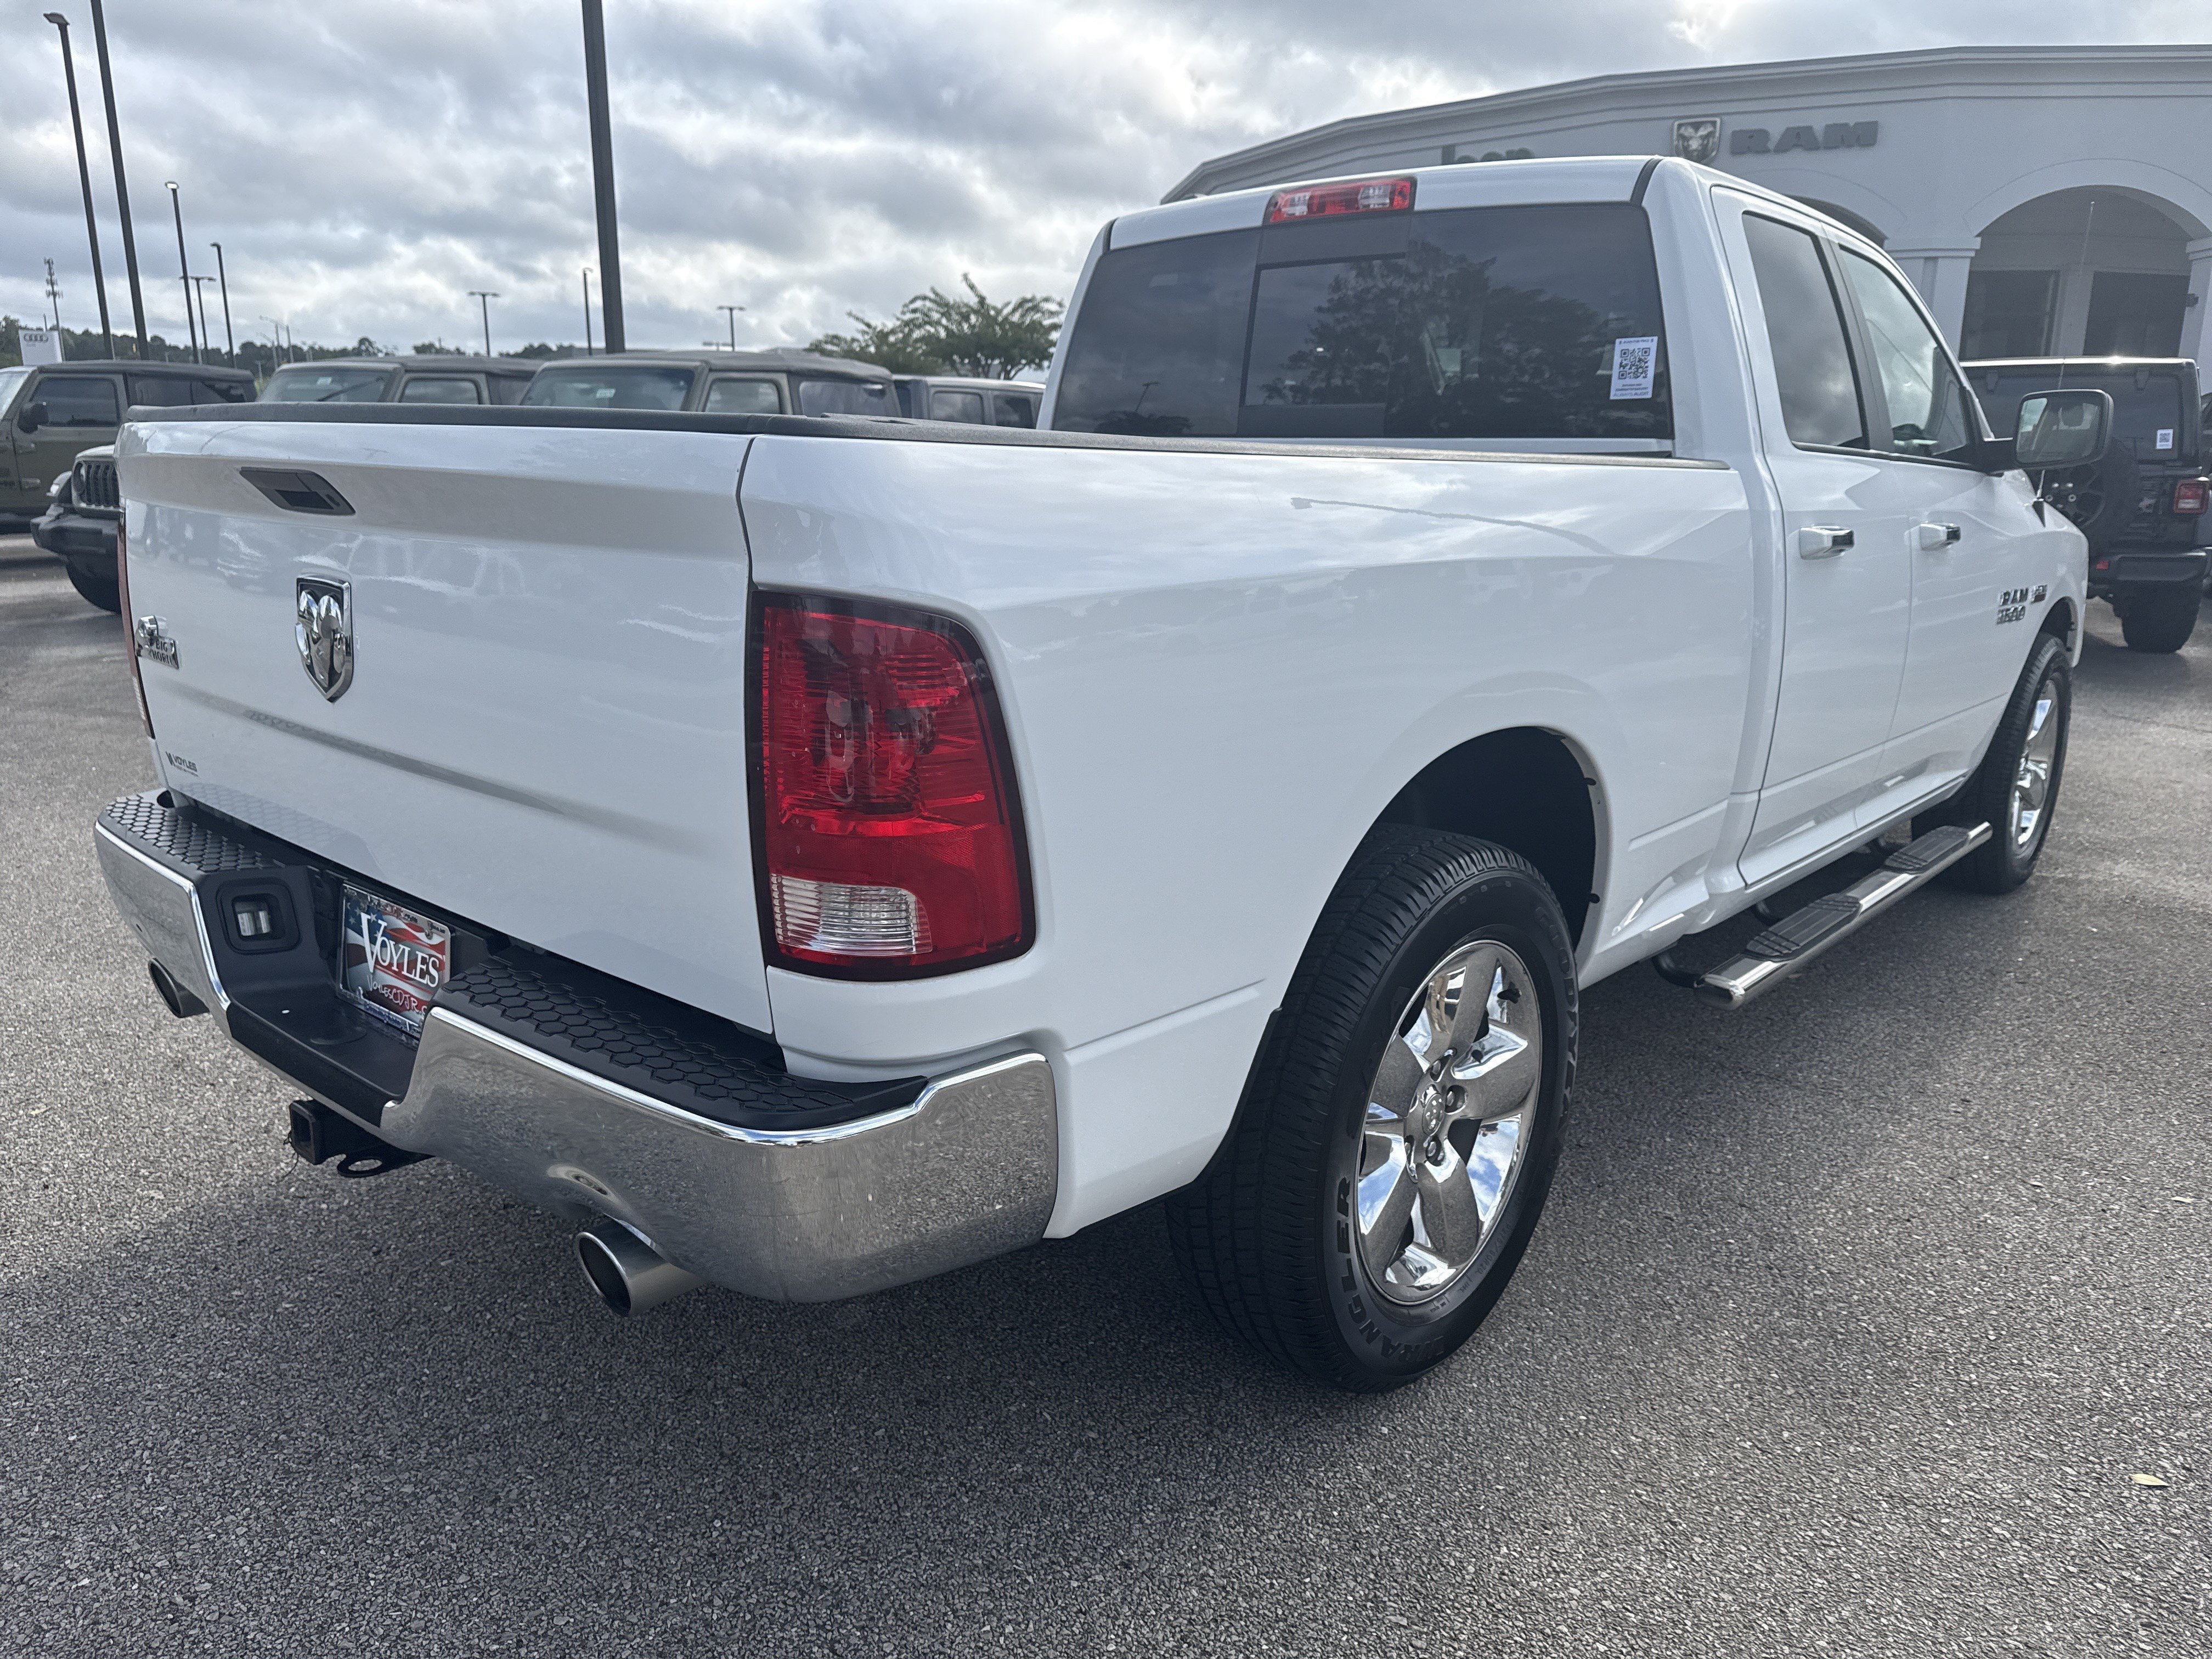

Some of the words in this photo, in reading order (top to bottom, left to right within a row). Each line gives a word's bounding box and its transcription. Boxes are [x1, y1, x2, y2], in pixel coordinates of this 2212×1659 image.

[1730, 120, 1878, 155] RAM
[1998, 587, 2029, 607] RAM
[1996, 605, 2026, 625] 1500
[156, 639, 168, 652] BIG
[172, 754, 197, 772] VOYLES
[361, 912, 439, 988] VOYLES
[1337, 1177, 1445, 1362] WRANGLER
